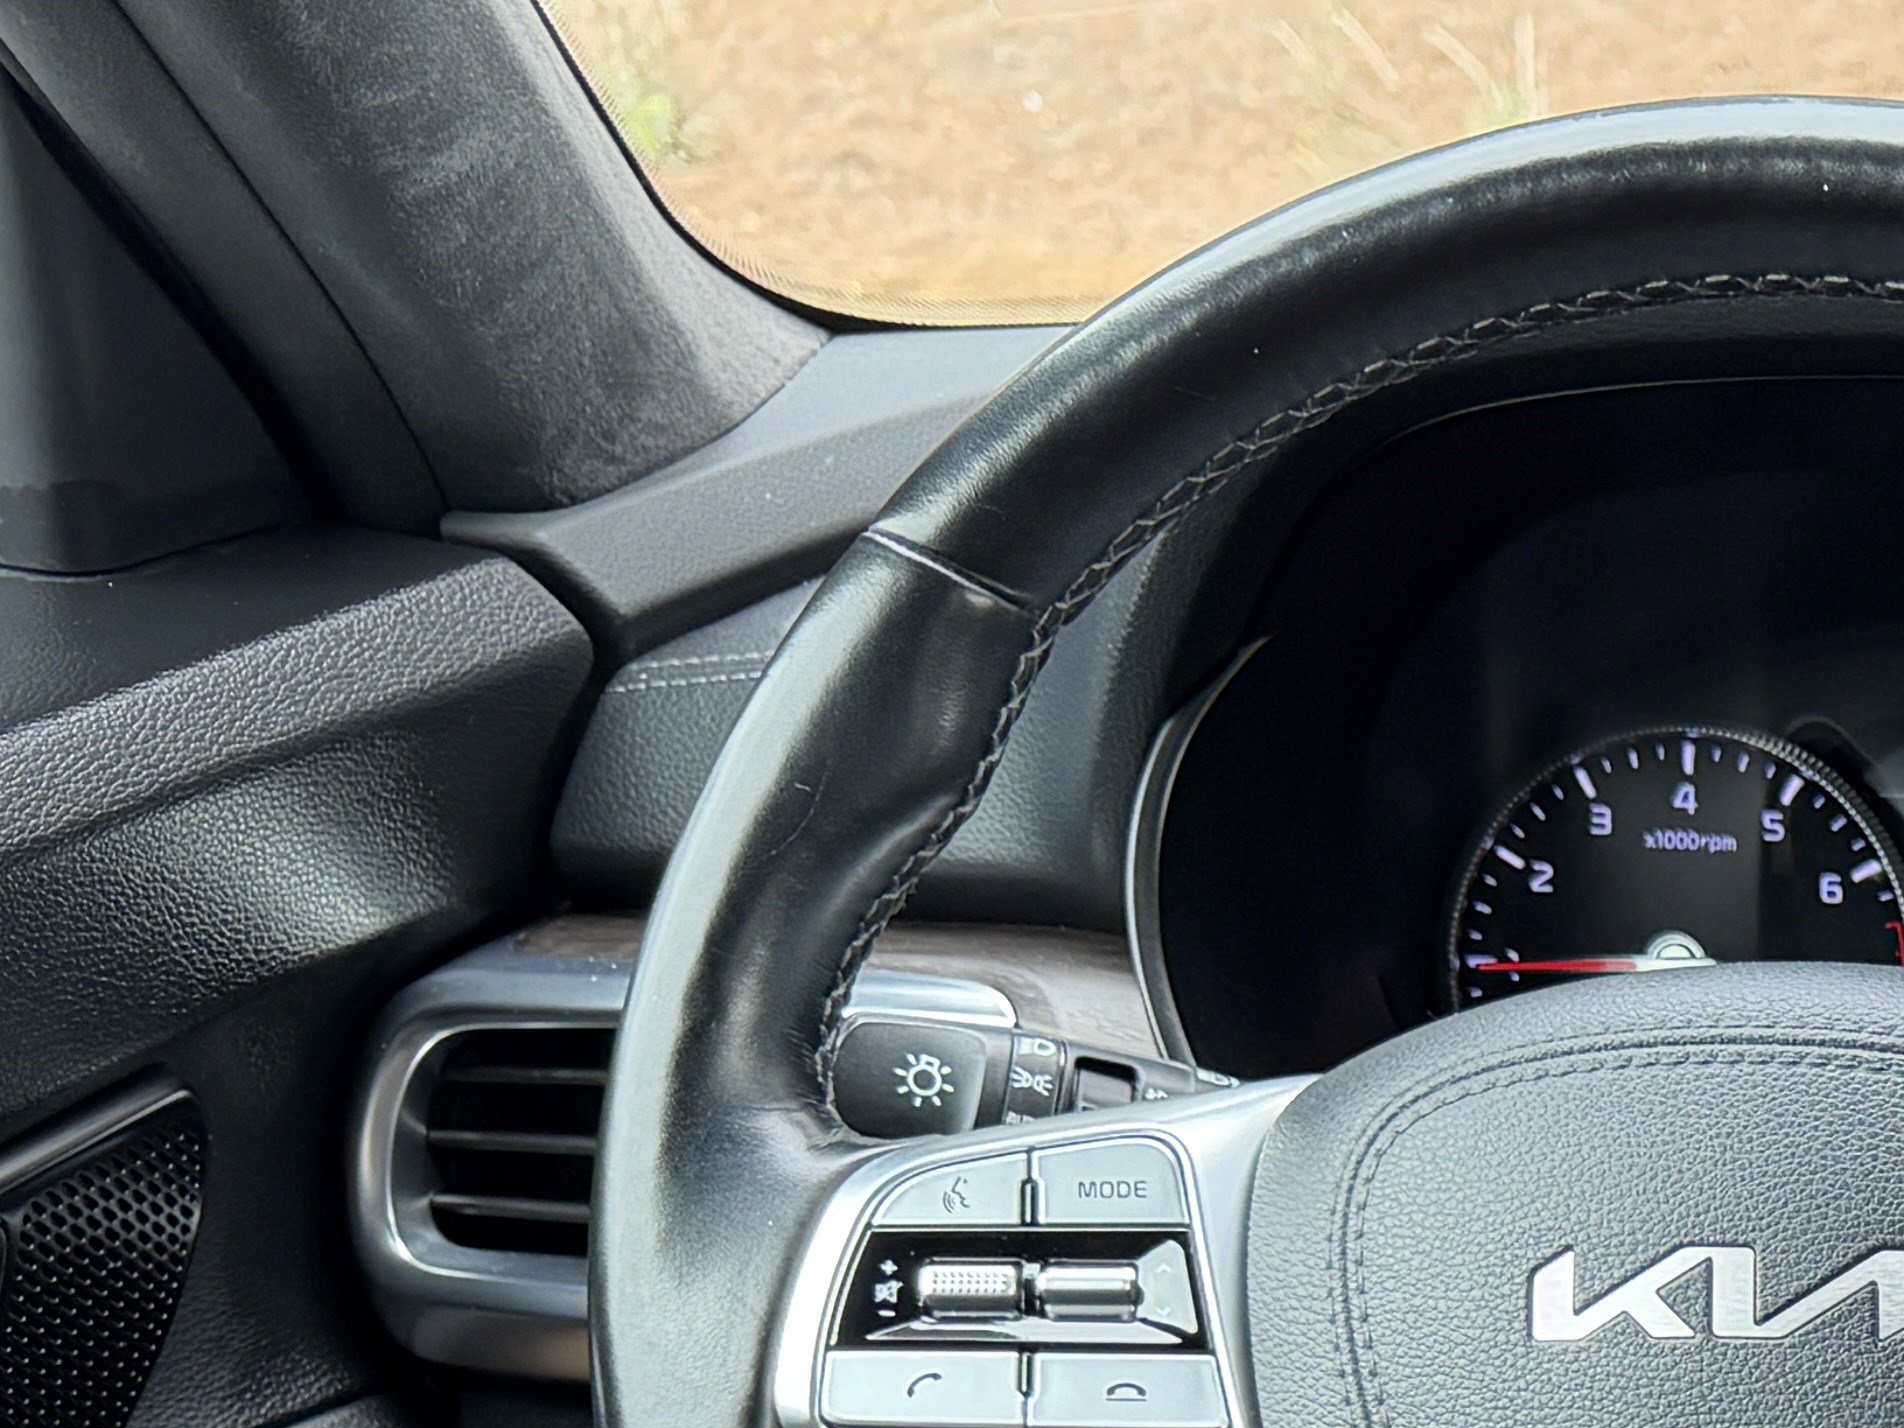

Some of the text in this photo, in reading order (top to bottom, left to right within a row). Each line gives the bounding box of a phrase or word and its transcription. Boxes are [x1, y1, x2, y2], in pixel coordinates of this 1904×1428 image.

[1673, 782, 1699, 815] 4
[1588, 803, 1613, 836] 3
[1761, 811, 1786, 842] 5
[1529, 861, 1555, 893] 2
[1818, 873, 1844, 905] 6
[1077, 1179, 1148, 1201] MODE
